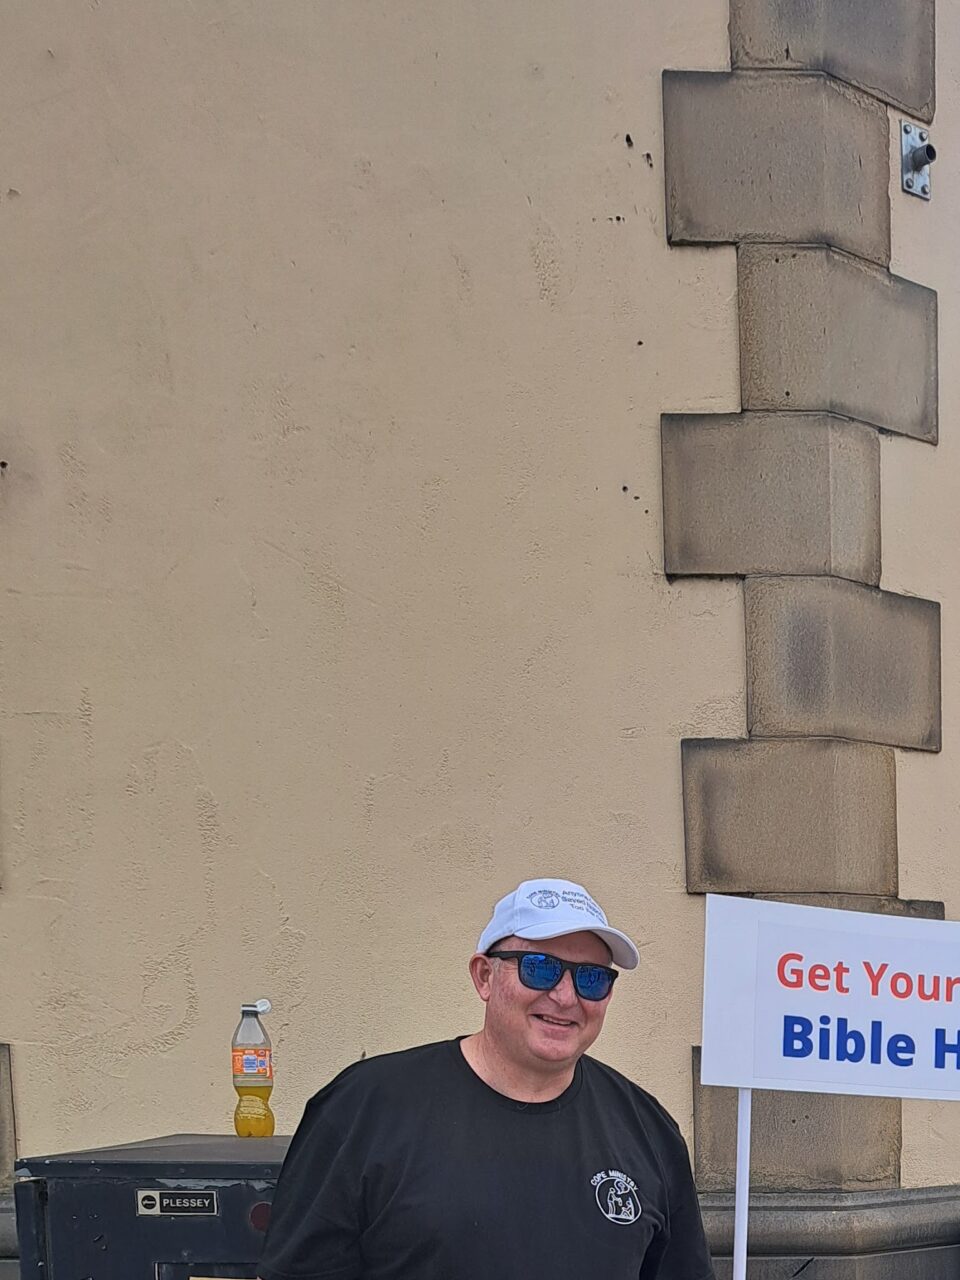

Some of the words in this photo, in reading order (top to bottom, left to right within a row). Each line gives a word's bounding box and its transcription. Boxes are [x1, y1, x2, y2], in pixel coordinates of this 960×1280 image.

[776, 953, 850, 994] Get
[782, 1015, 916, 1067] Bible
[590, 1171, 607, 1186] COPE
[609, 1169, 638, 1190] MINISTRY
[163, 1198, 211, 1207] PLESSEY
